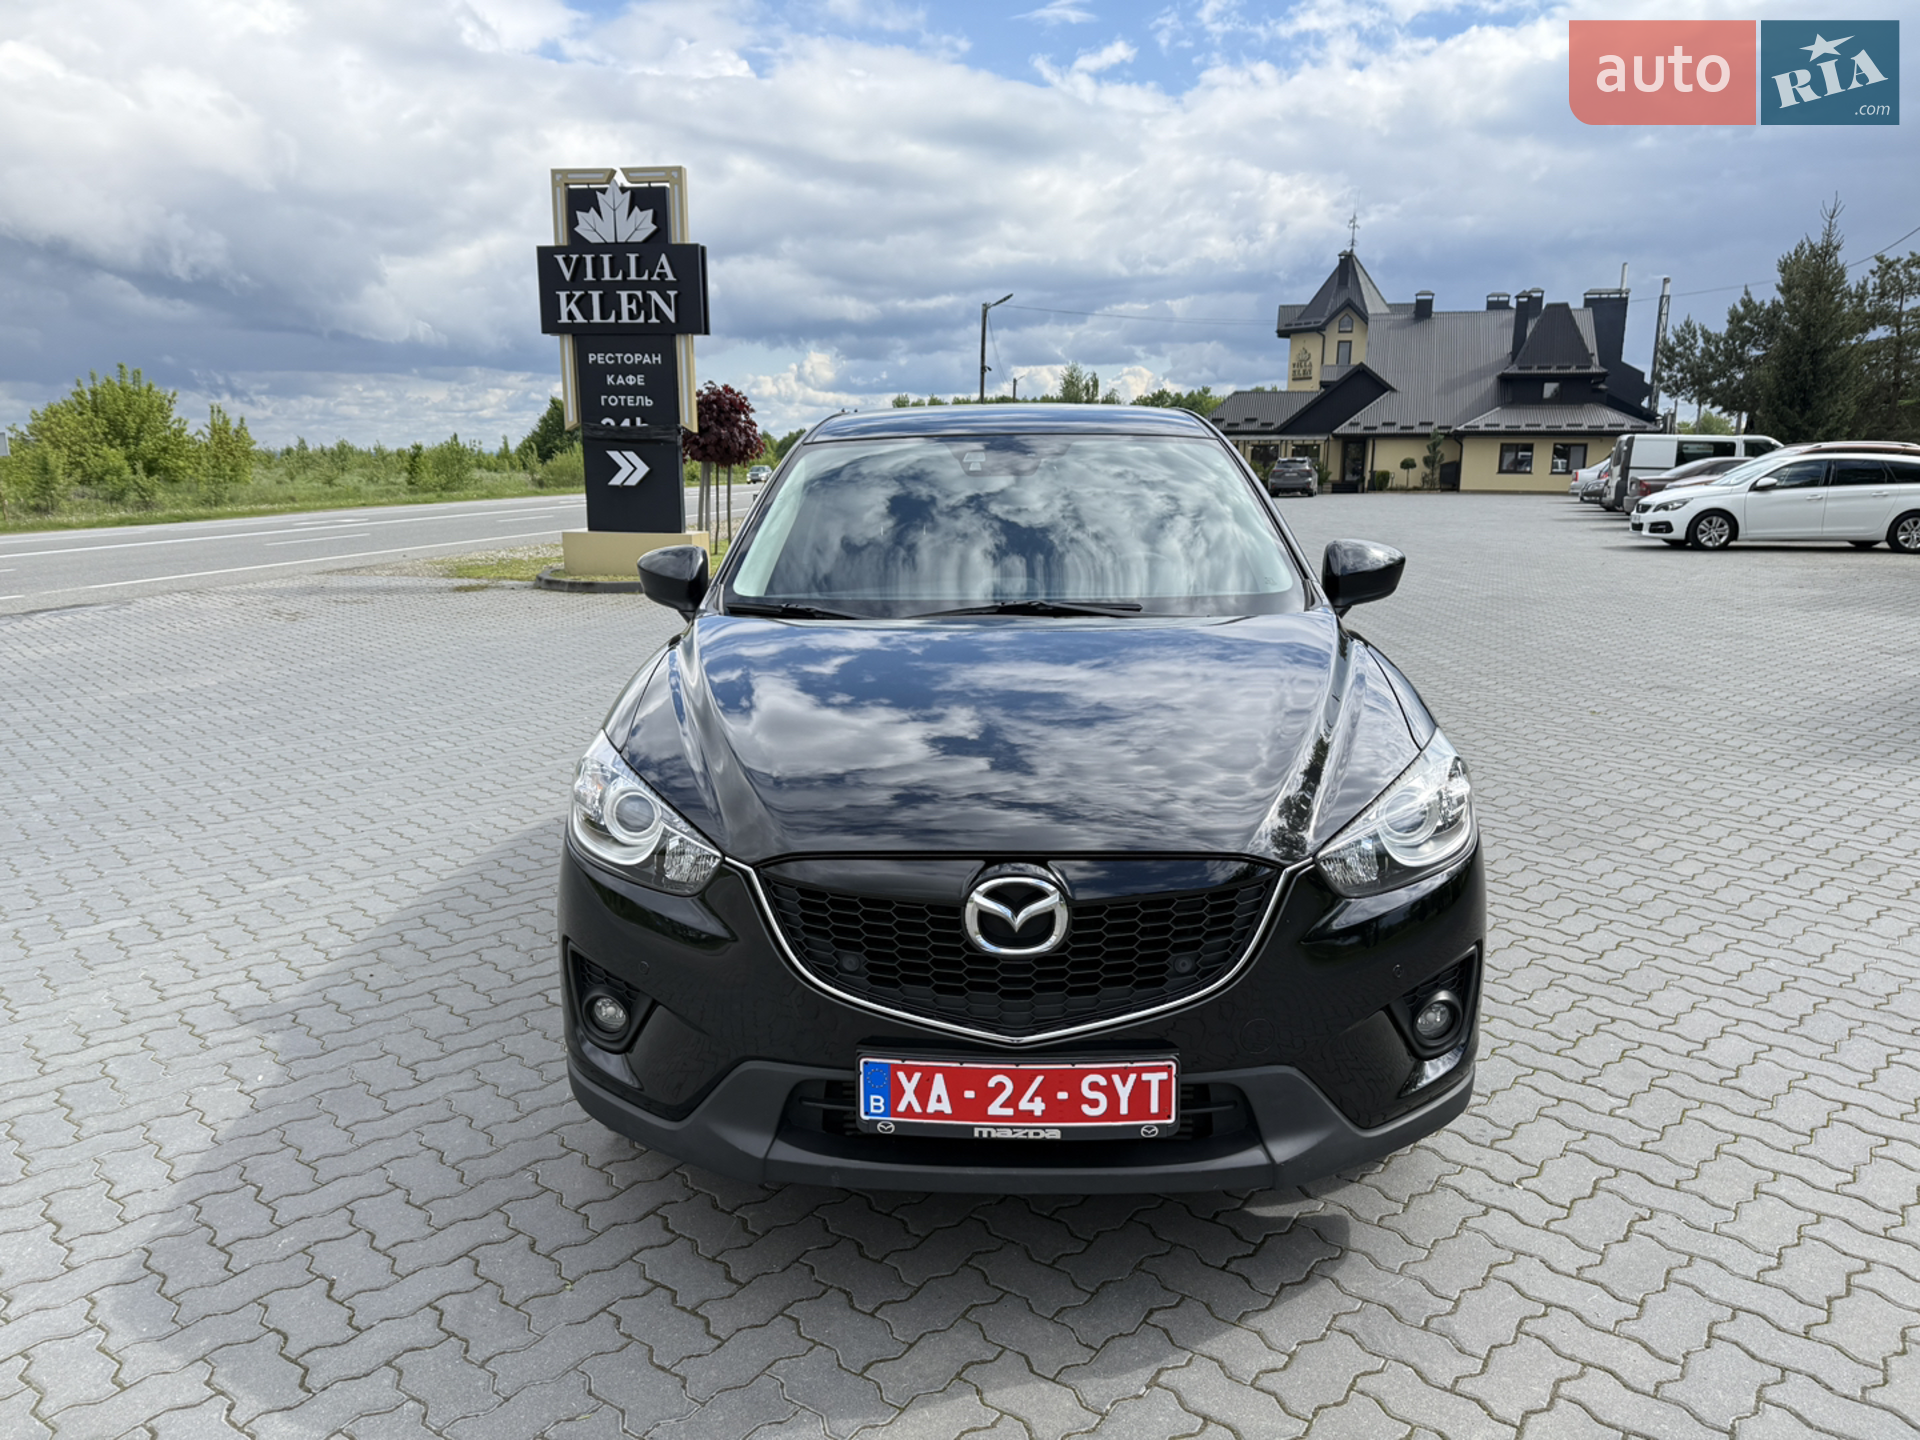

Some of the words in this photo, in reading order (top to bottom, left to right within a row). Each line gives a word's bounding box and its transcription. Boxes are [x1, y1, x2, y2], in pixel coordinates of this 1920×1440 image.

[553, 253, 677, 282] VILLA
[555, 290, 678, 324] KLEN
[588, 353, 662, 365] РЕСТОРАН
[606, 374, 646, 386] КАФЕ
[600, 395, 654, 407] ГОТЕЛЬ
[869, 1095, 885, 1114] B
